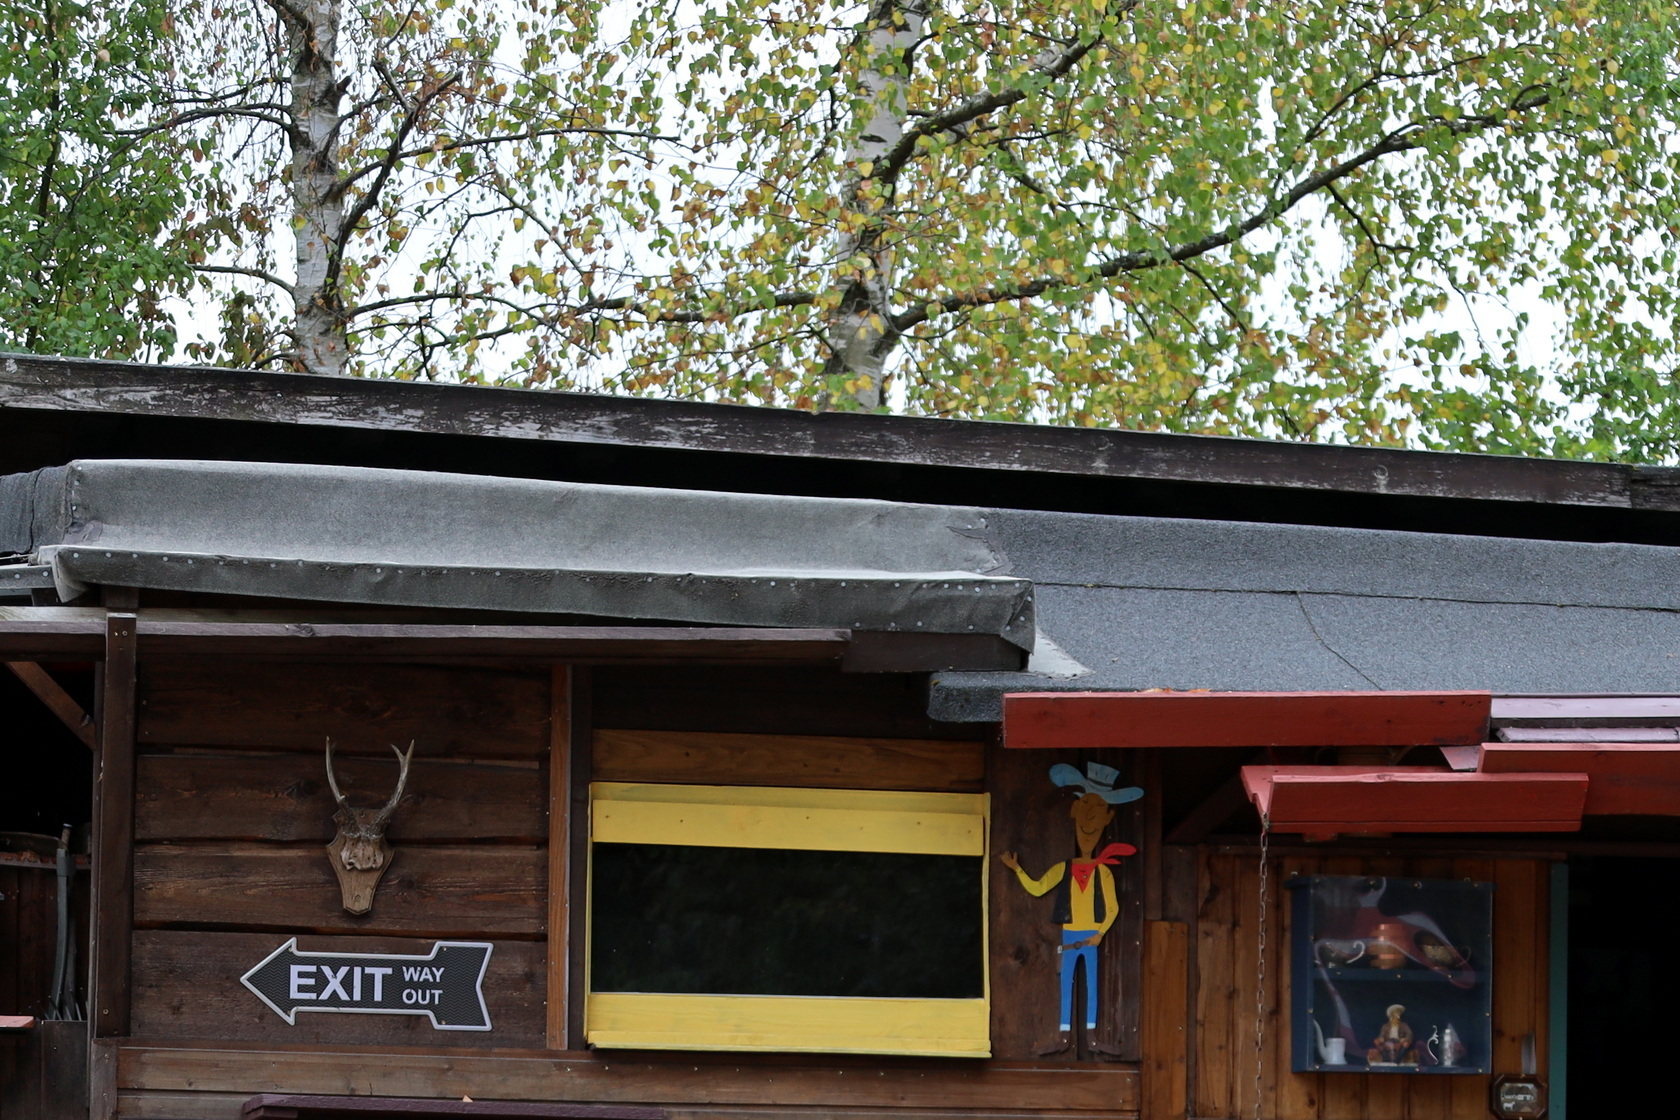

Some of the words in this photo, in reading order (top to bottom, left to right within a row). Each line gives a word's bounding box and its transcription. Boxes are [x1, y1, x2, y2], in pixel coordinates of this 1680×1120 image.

[289, 964, 393, 1002] EXIT
[402, 966, 445, 983] WAY
[402, 989, 443, 1005] OUT
